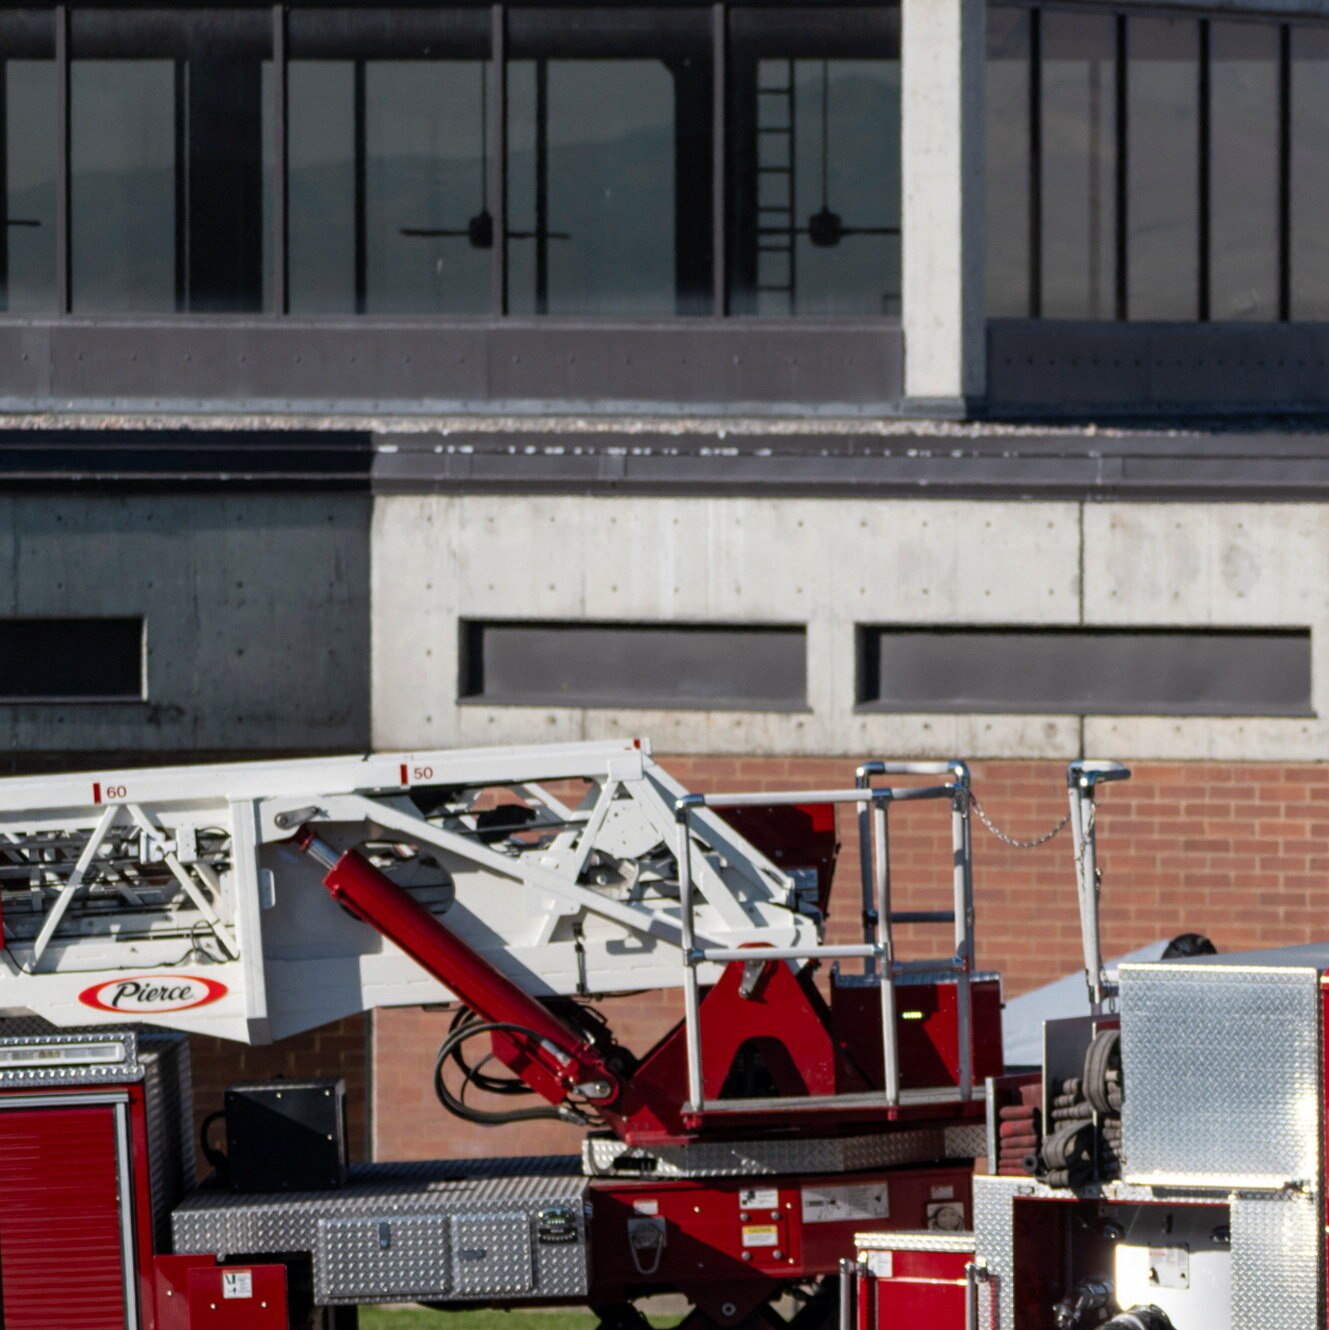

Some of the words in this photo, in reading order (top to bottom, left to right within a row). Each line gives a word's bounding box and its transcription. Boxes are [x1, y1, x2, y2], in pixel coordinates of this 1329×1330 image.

[413, 767, 433, 780] 50
[106, 786, 127, 798] 60
[111, 980, 193, 1008] Pierce
